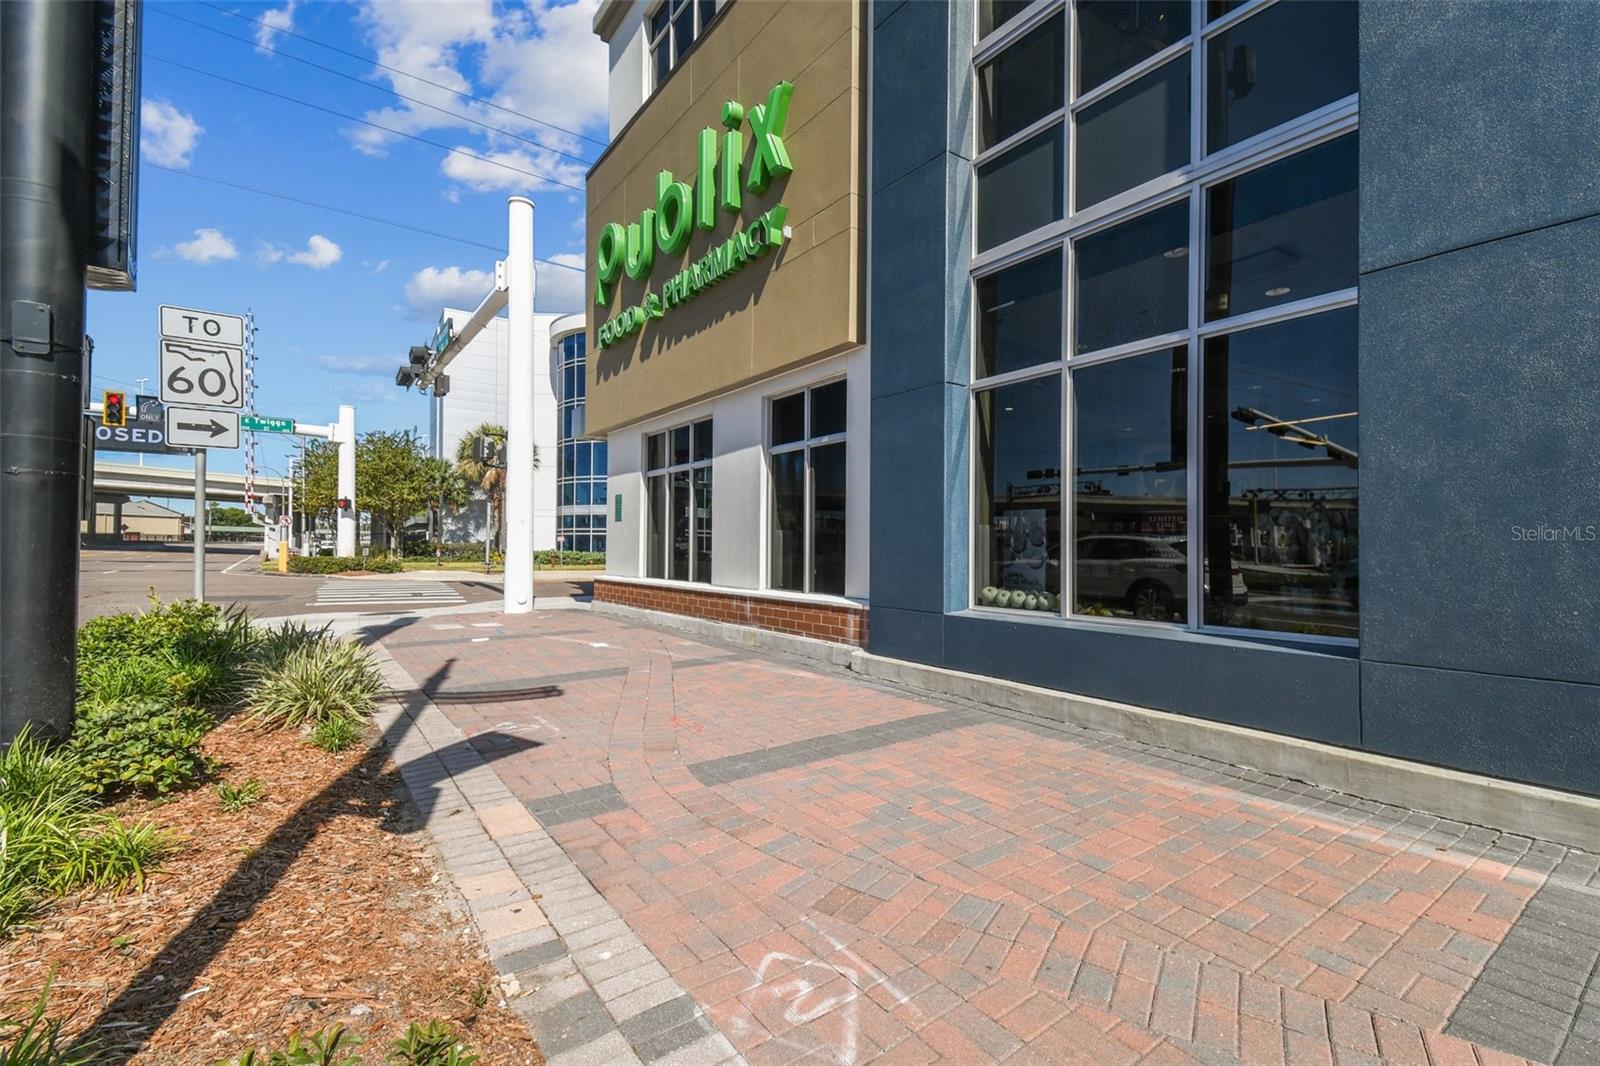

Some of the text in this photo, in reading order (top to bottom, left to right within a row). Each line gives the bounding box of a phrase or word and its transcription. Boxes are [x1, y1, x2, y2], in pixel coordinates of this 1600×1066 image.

[595, 80, 794, 306] publix
[598, 203, 788, 349] FOOD & PHARMACY
[182, 315, 221, 336] TO
[167, 366, 226, 397] 60
[140, 413, 160, 421] ONLY
[254, 417, 286, 427] Twiggs
[95, 426, 163, 443] OSED
